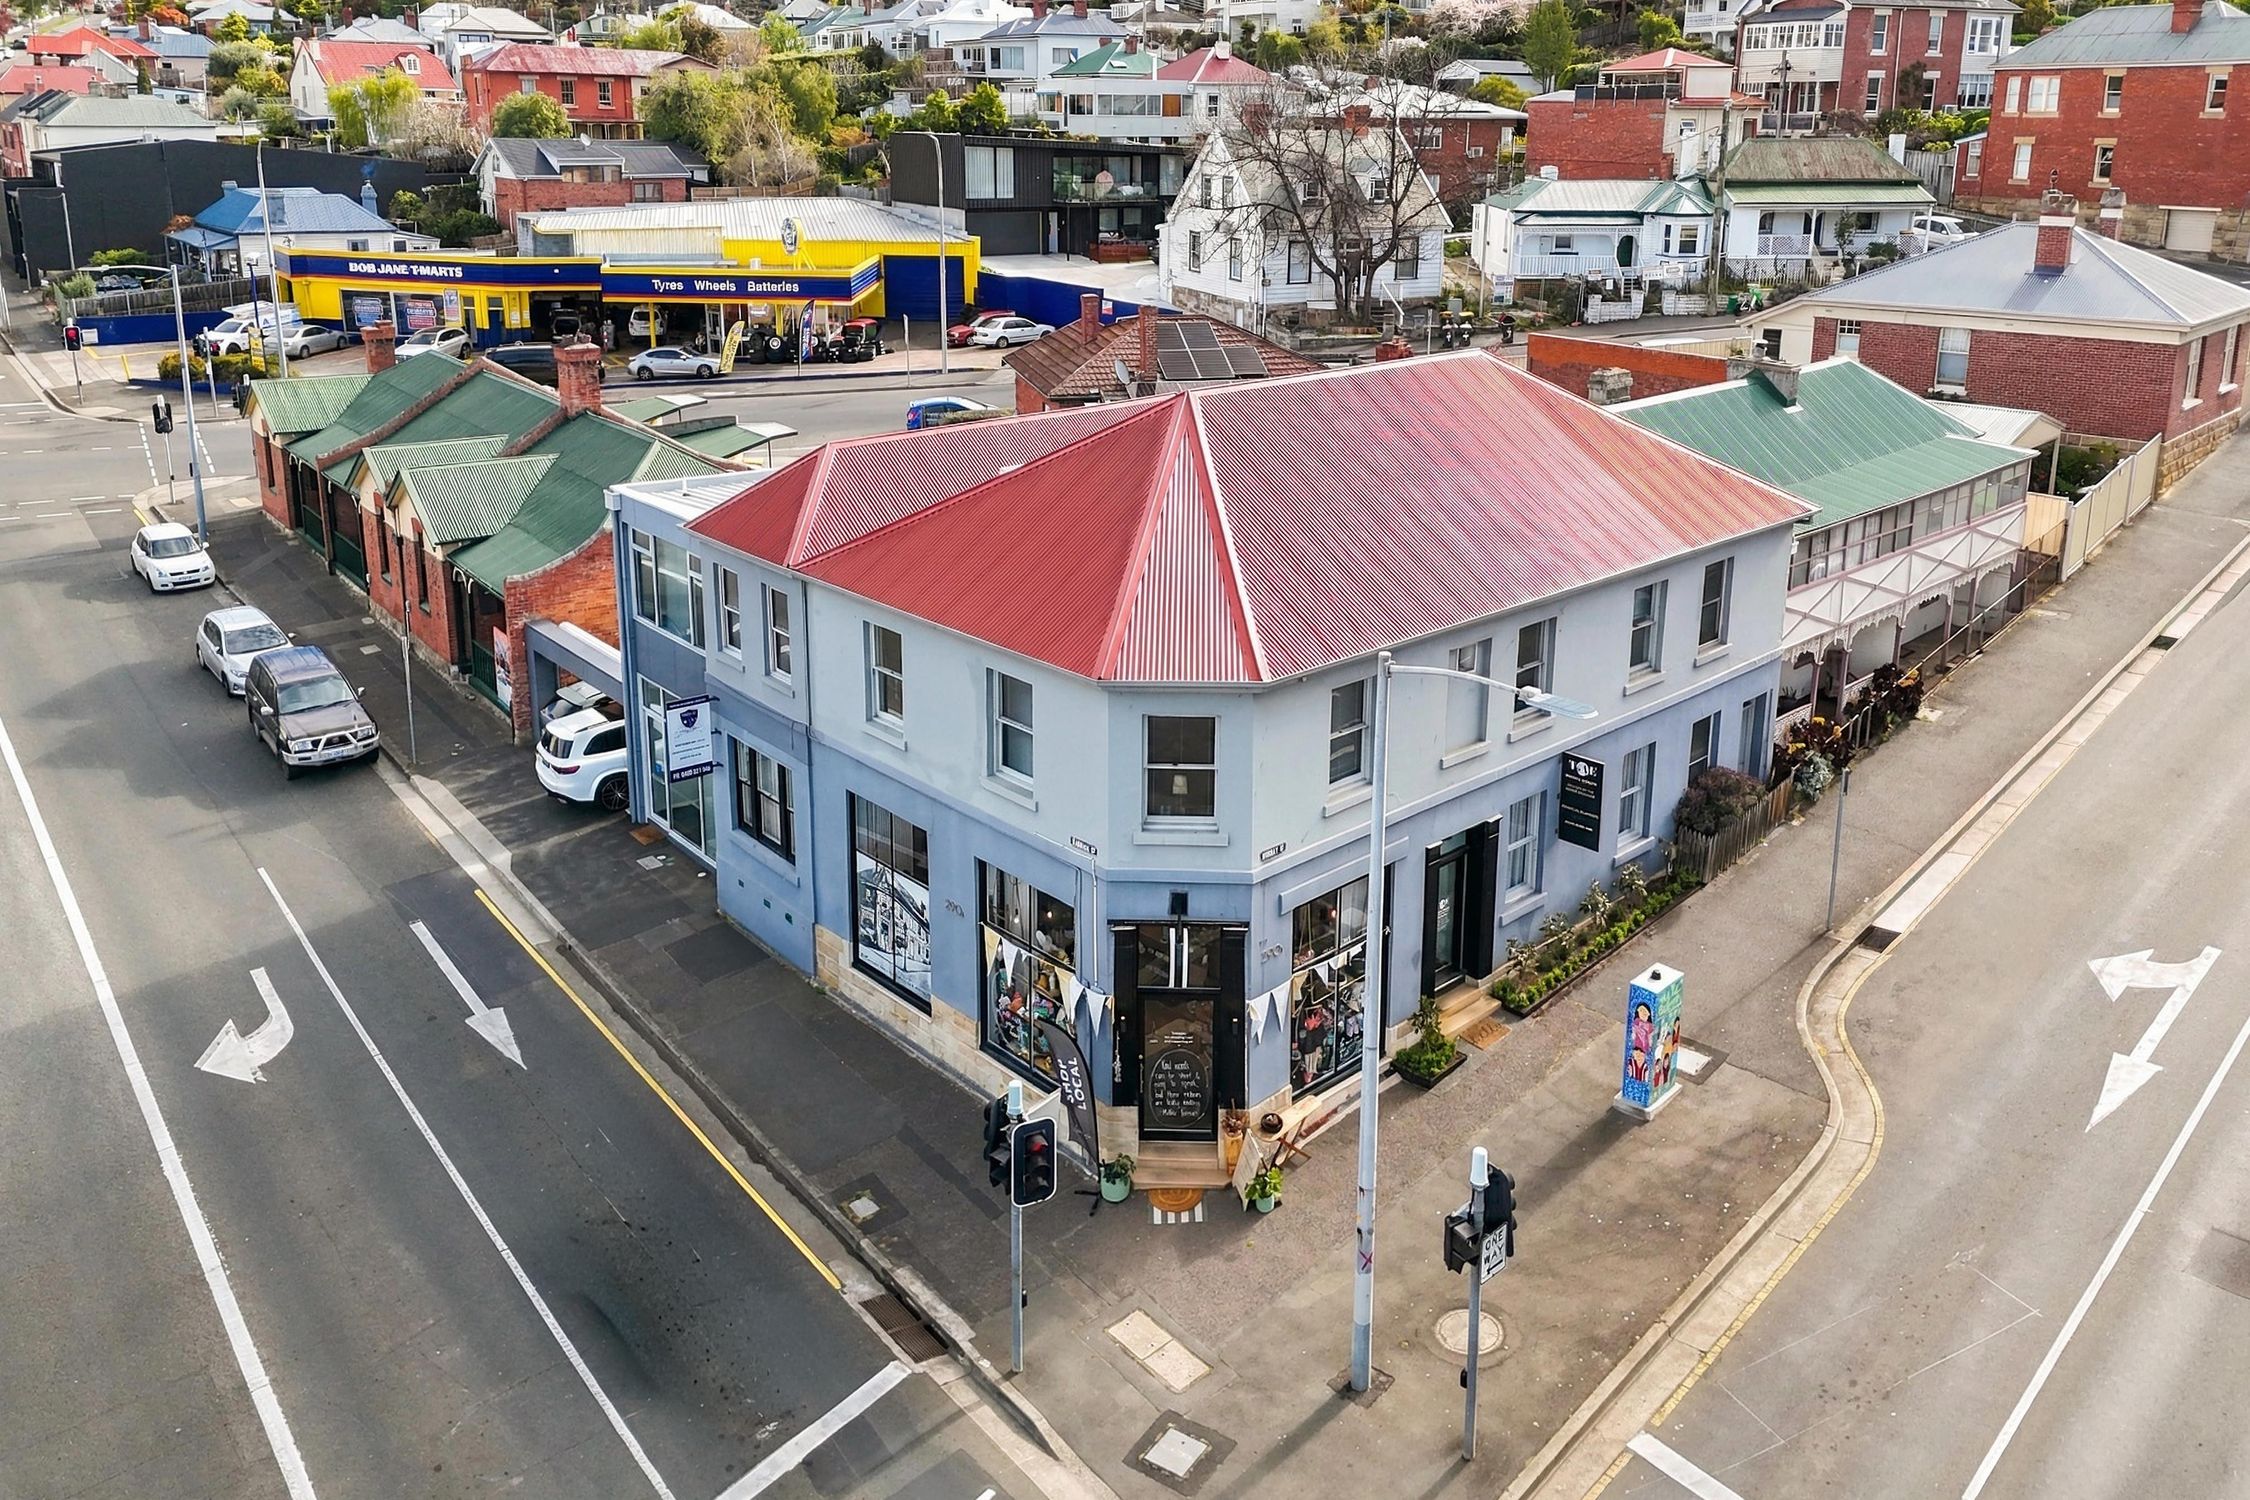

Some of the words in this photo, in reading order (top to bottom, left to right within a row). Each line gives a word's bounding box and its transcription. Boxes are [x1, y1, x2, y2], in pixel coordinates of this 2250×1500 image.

[348, 262, 376, 273] BOB
[377, 263, 409, 275] JANE
[410, 265, 463, 278] T-MARTS
[652, 279, 684, 292] Tyres
[694, 280, 736, 291] Wheels
[747, 281, 799, 292] Batteries
[1067, 1056, 1087, 1111] LOCAL
[1485, 1229, 1503, 1251] ONE
[1484, 1242, 1504, 1265] WAY
